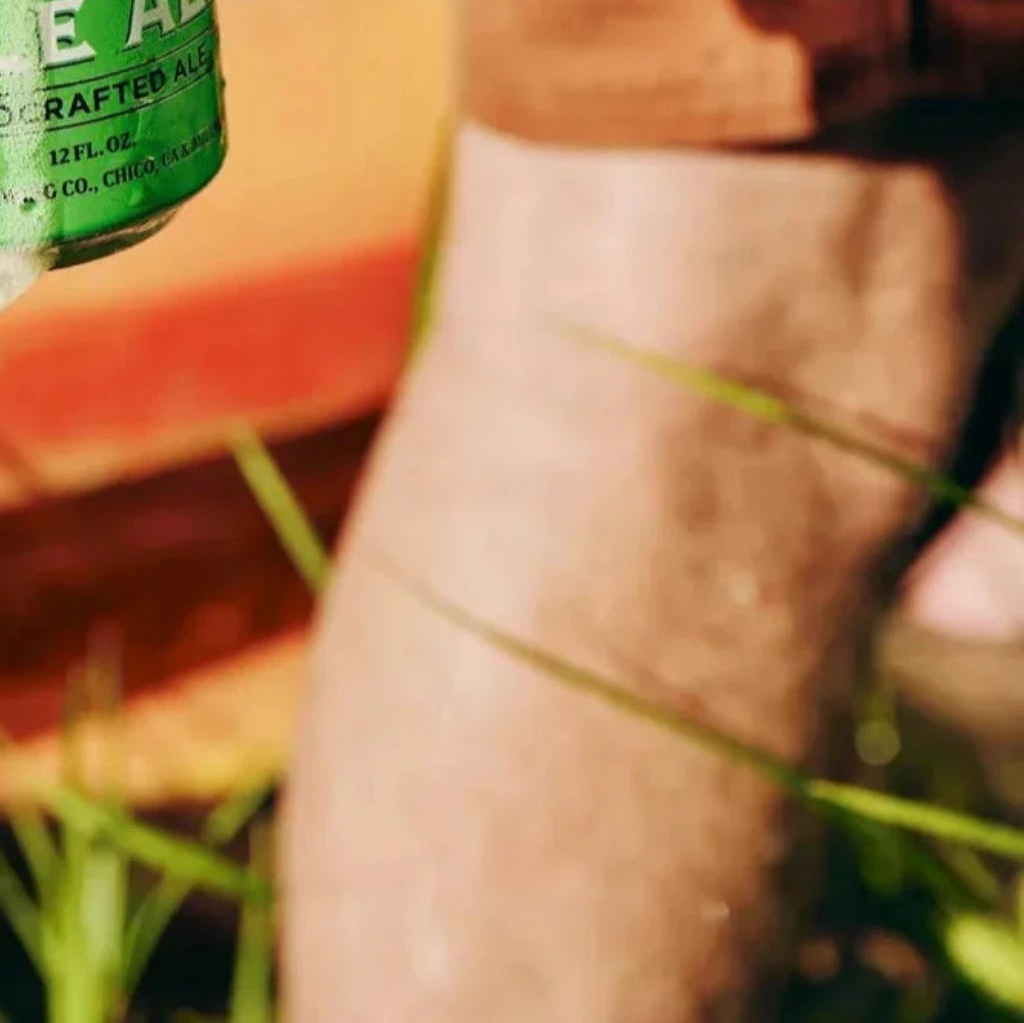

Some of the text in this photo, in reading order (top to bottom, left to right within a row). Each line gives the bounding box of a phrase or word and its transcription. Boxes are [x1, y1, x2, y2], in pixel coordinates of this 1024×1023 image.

[173, 44, 210, 83] ALE
[49, 131, 137, 167] 12 FL. OZ.
[62, 177, 99, 197] CO.,
[103, 158, 159, 188] CHICO,
